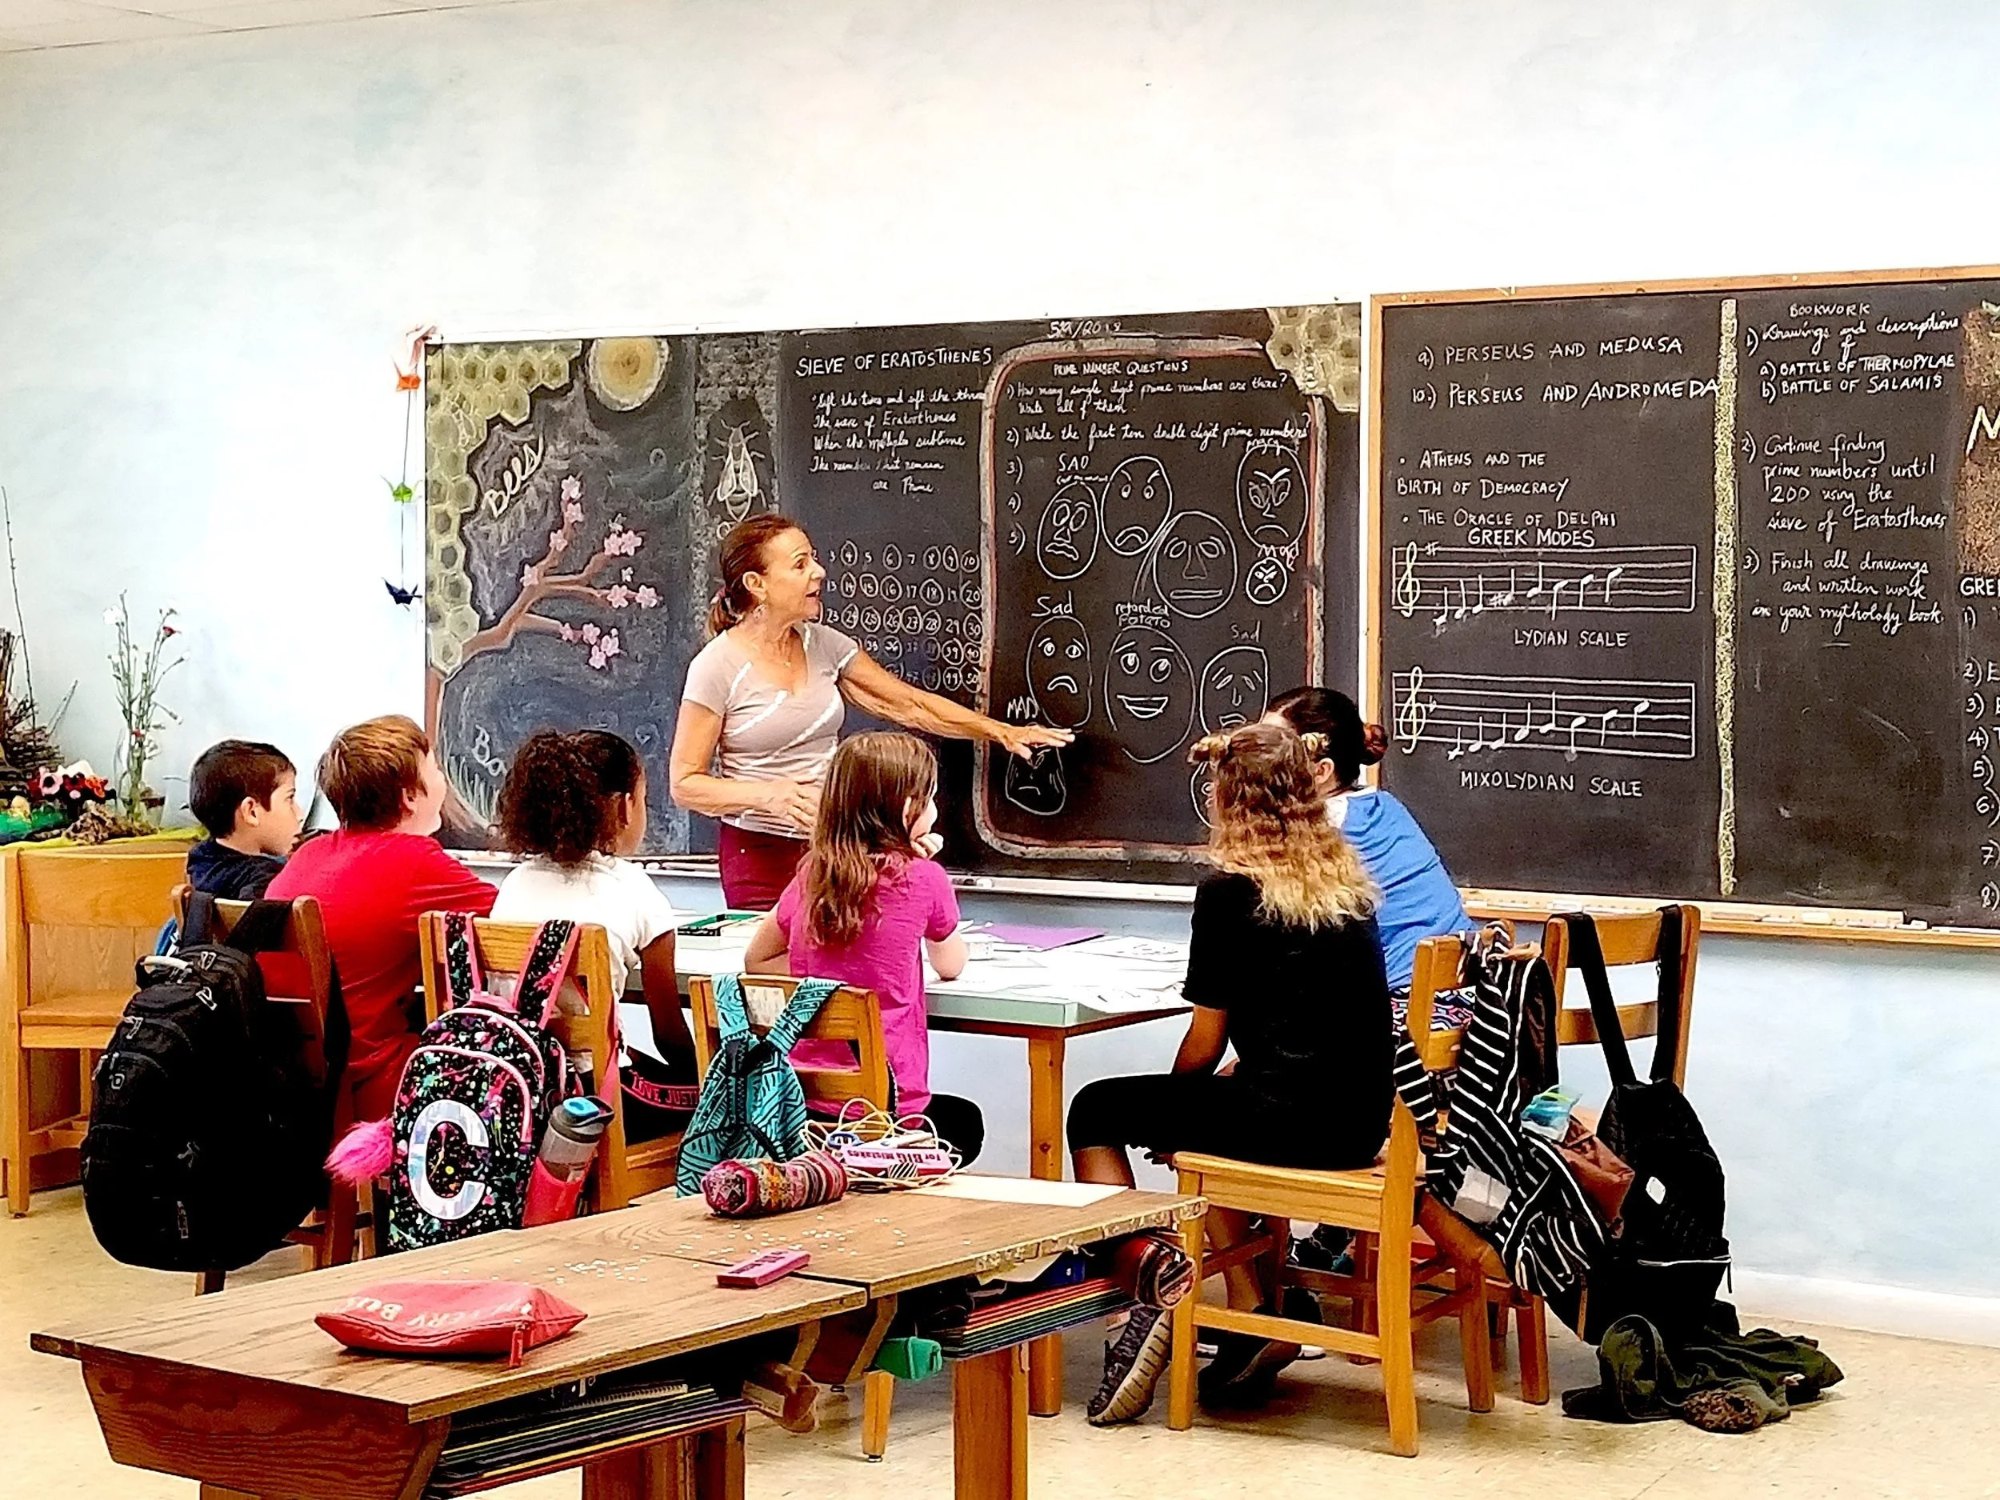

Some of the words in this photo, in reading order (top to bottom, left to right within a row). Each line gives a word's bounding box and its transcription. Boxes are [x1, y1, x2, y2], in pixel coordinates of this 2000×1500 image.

[1790, 303, 1871, 317] BOOKWORK
[1839, 321, 1866, 336] and
[796, 357, 845, 376] SIEVE
[855, 354, 875, 370] OF
[881, 347, 992, 369] ERATOSTHENES
[1445, 343, 1535, 365] PERSEUS
[1549, 342, 1585, 358] AND
[1600, 335, 1683, 356] MEDUSA
[1780, 358, 1832, 376] BATTLE
[1858, 353, 1956, 373] THERMOPYLAE
[1449, 382, 1524, 409] PERSEUS
[1543, 383, 1578, 402] AND
[1582, 378, 1720, 409] ANDROMEDA
[1781, 376, 1832, 395] BATTLE
[1840, 378, 1860, 393] OF
[1867, 372, 1943, 394] SALAMIS
[1420, 450, 1472, 470] ATHENS
[1485, 452, 1510, 466] AND
[1518, 453, 1546, 466] THE
[1764, 435, 1822, 456] Continue
[1829, 431, 1886, 465] finding
[1762, 463, 1801, 492] prime
[1810, 457, 1878, 480] numbers
[1891, 453, 1935, 478] until
[1397, 478, 1441, 496] BIRTH
[1453, 481, 1471, 494] OF
[1480, 478, 1569, 501] DEMOCRACY
[1770, 484, 1810, 503] 200
[1822, 489, 1855, 517] using
[1868, 482, 1894, 503] the
[1418, 508, 1445, 526] THE
[1454, 507, 1513, 527] ORACLE
[1525, 513, 1544, 527] OF
[1557, 510, 1617, 528] DELPHI
[1767, 510, 1807, 531] sieve
[1817, 509, 1838, 543] of
[1853, 506, 1947, 531] Eratosthenes
[1468, 527, 1528, 547] GREEK
[1536, 528, 1595, 547] MODES
[865, 551, 872, 563] 5
[907, 553, 915, 565] 7
[1771, 551, 1814, 576] Finish
[1824, 549, 1849, 570] all
[906, 584, 917, 598] 17
[966, 589, 980, 602] 20
[1783, 575, 1811, 593] and
[1818, 576, 1878, 595] written
[1886, 578, 1926, 600] work
[1960, 576, 2000, 596] GRE
[1032, 590, 1073, 617] Sad
[826, 608, 839, 623] 23
[945, 619, 960, 635] 29
[967, 622, 981, 637] 30
[1779, 606, 1812, 633] your
[1819, 599, 1902, 636] mythology
[1514, 629, 1568, 647] LYDIAN
[1579, 631, 1630, 647] SCALE
[945, 646, 959, 660] 39
[1007, 696, 1040, 719] MAD
[1461, 771, 1574, 792] MIXOLYDIAN
[1589, 778, 1643, 798] SCALE
[407, 1100, 490, 1220] C
